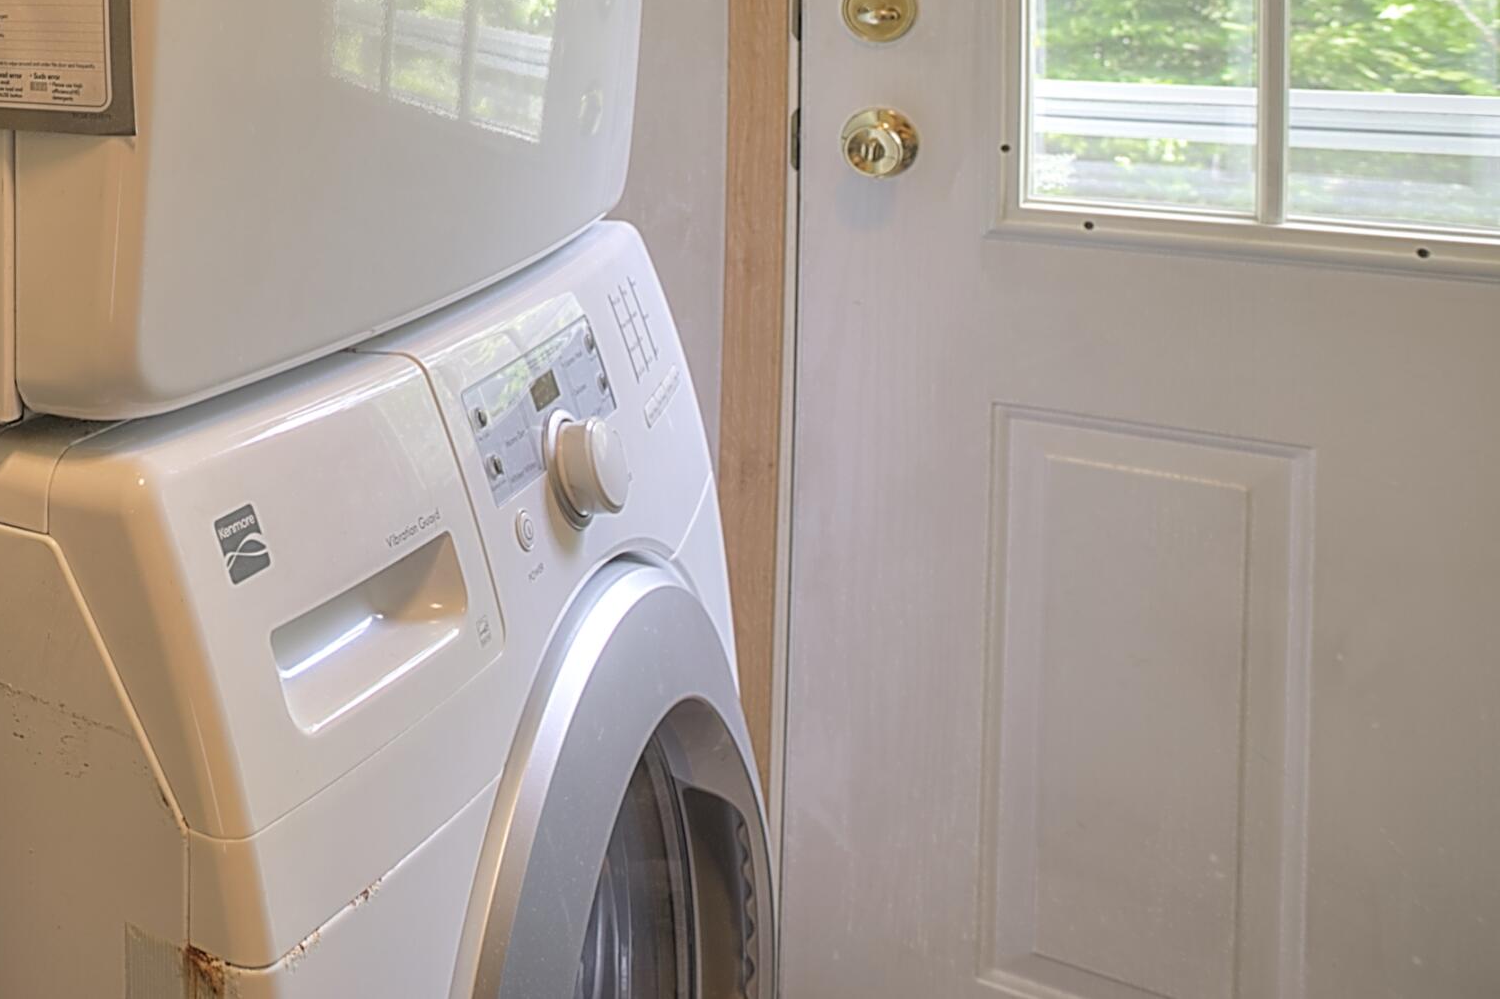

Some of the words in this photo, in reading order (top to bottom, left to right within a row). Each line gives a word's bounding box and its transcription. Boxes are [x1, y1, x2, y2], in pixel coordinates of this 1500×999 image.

[217, 513, 256, 541] Kenmore
[385, 522, 418, 549] Vibration
[417, 506, 442, 533] Guard
